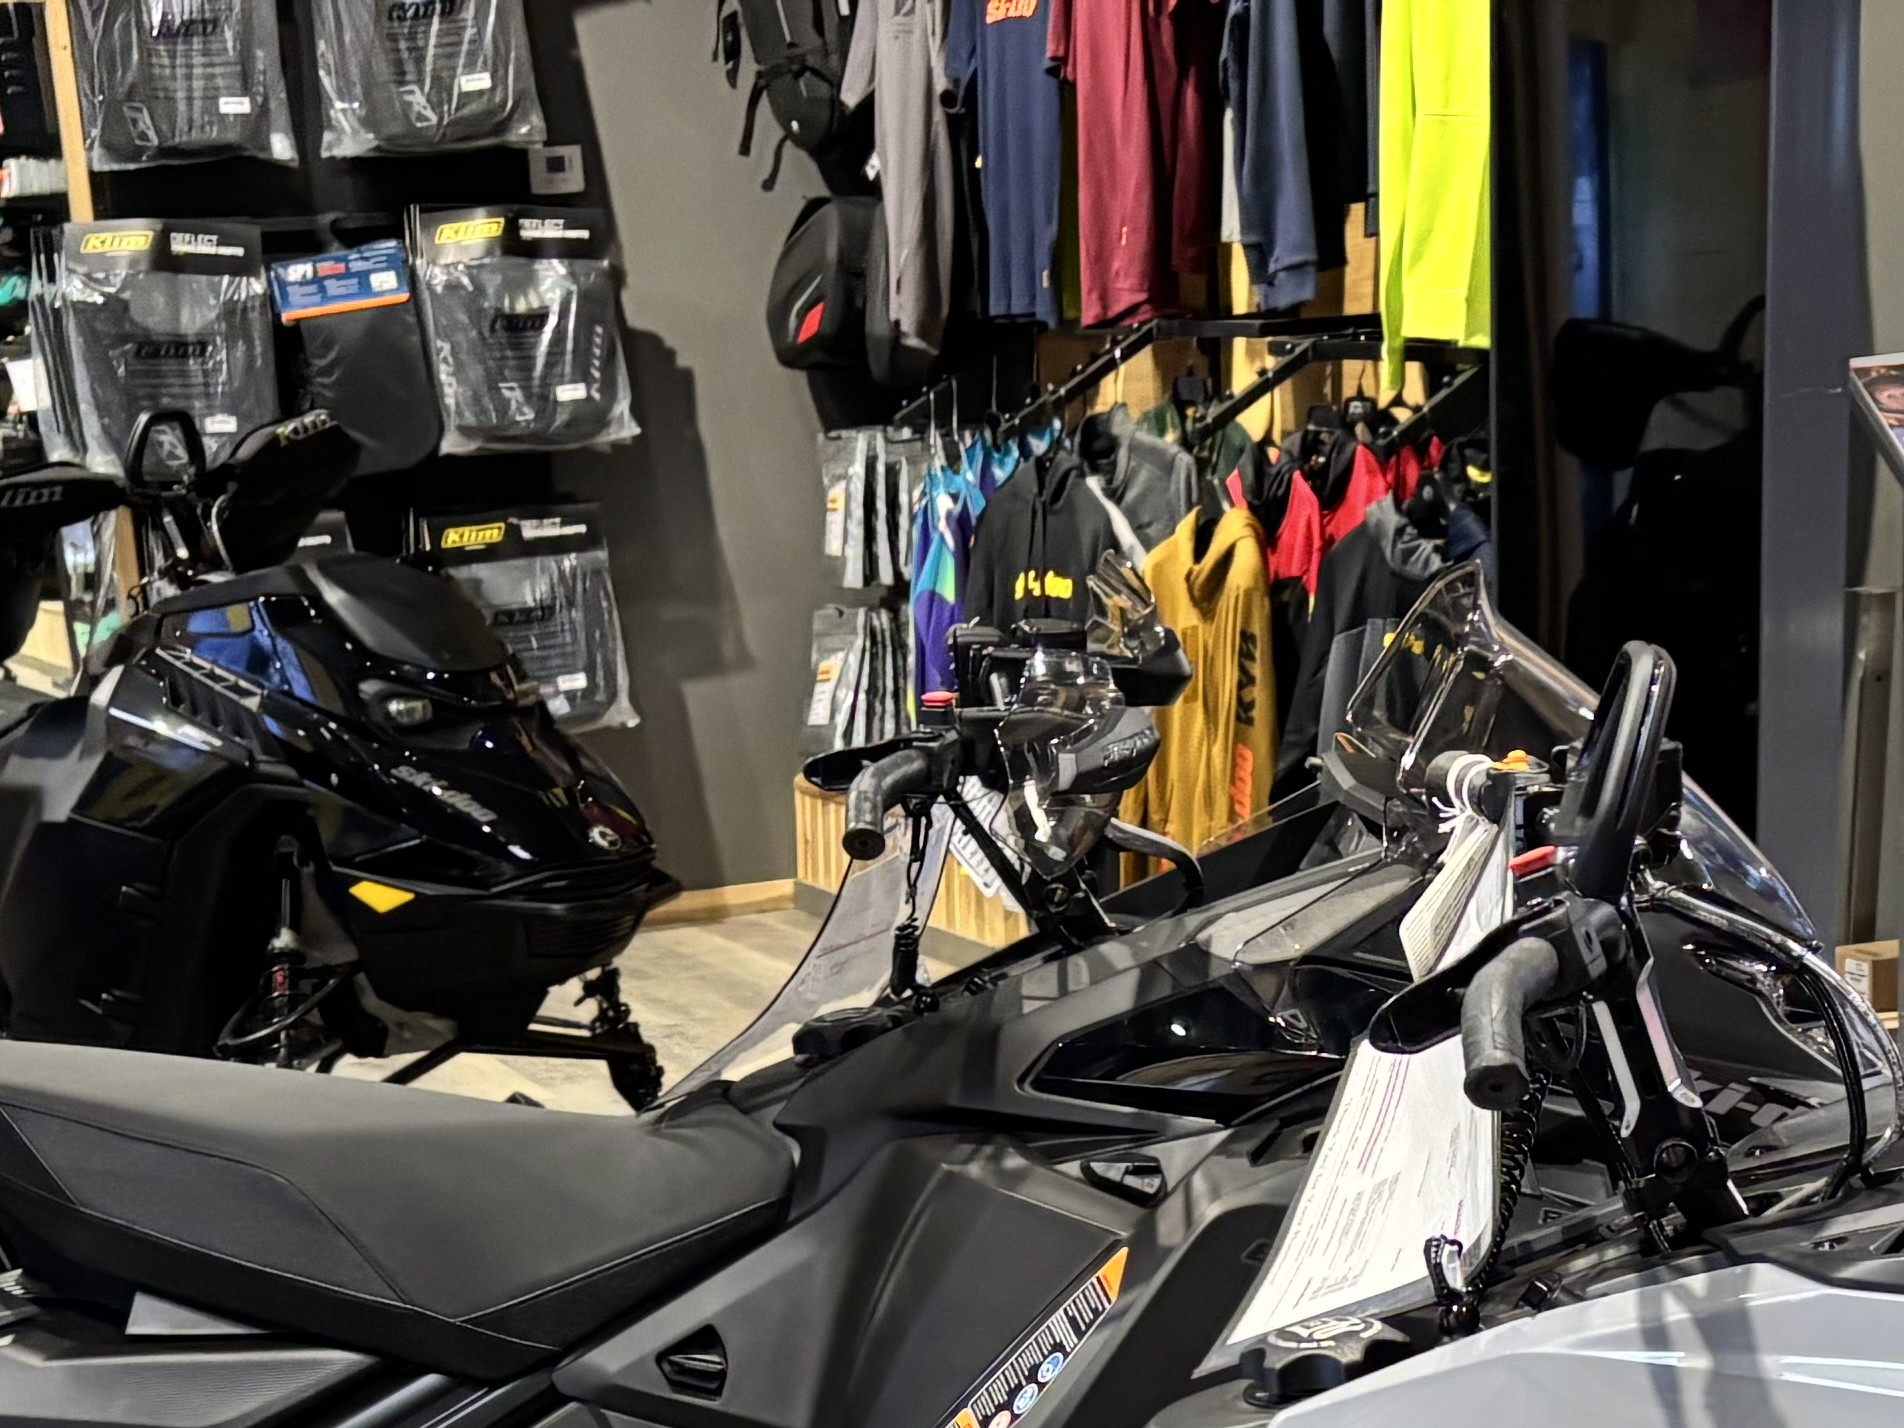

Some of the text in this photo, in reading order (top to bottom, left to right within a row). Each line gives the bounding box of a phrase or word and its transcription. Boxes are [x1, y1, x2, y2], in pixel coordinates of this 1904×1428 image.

[438, 220, 502, 242] Klim
[84, 233, 152, 251] Klim
[445, 526, 501, 545] Klim
